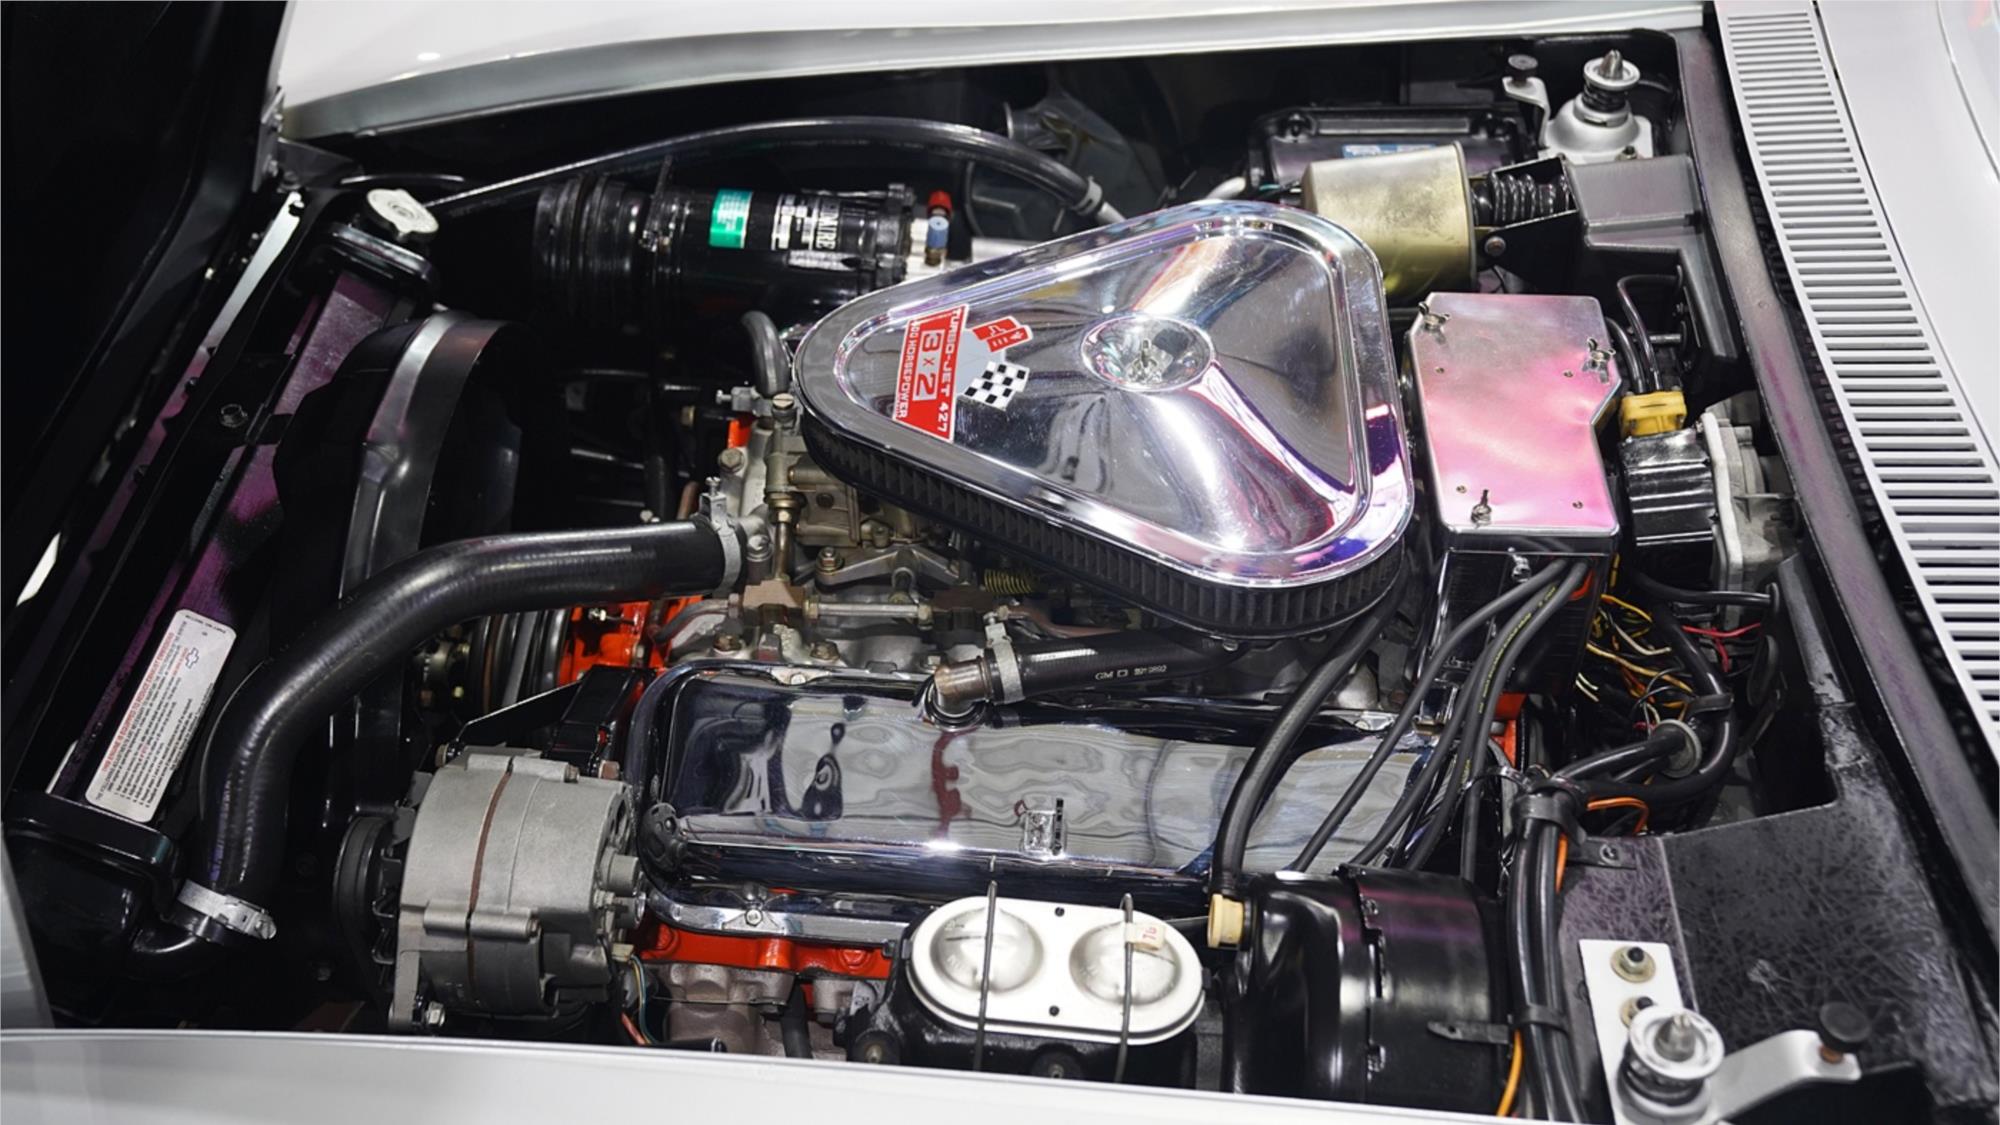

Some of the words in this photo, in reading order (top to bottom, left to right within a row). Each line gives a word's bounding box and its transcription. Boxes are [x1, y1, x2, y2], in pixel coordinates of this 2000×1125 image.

[899, 339, 918, 418] HORSEPOWER
[941, 309, 961, 397] TURBO-JET
[937, 402, 949, 432] 427
